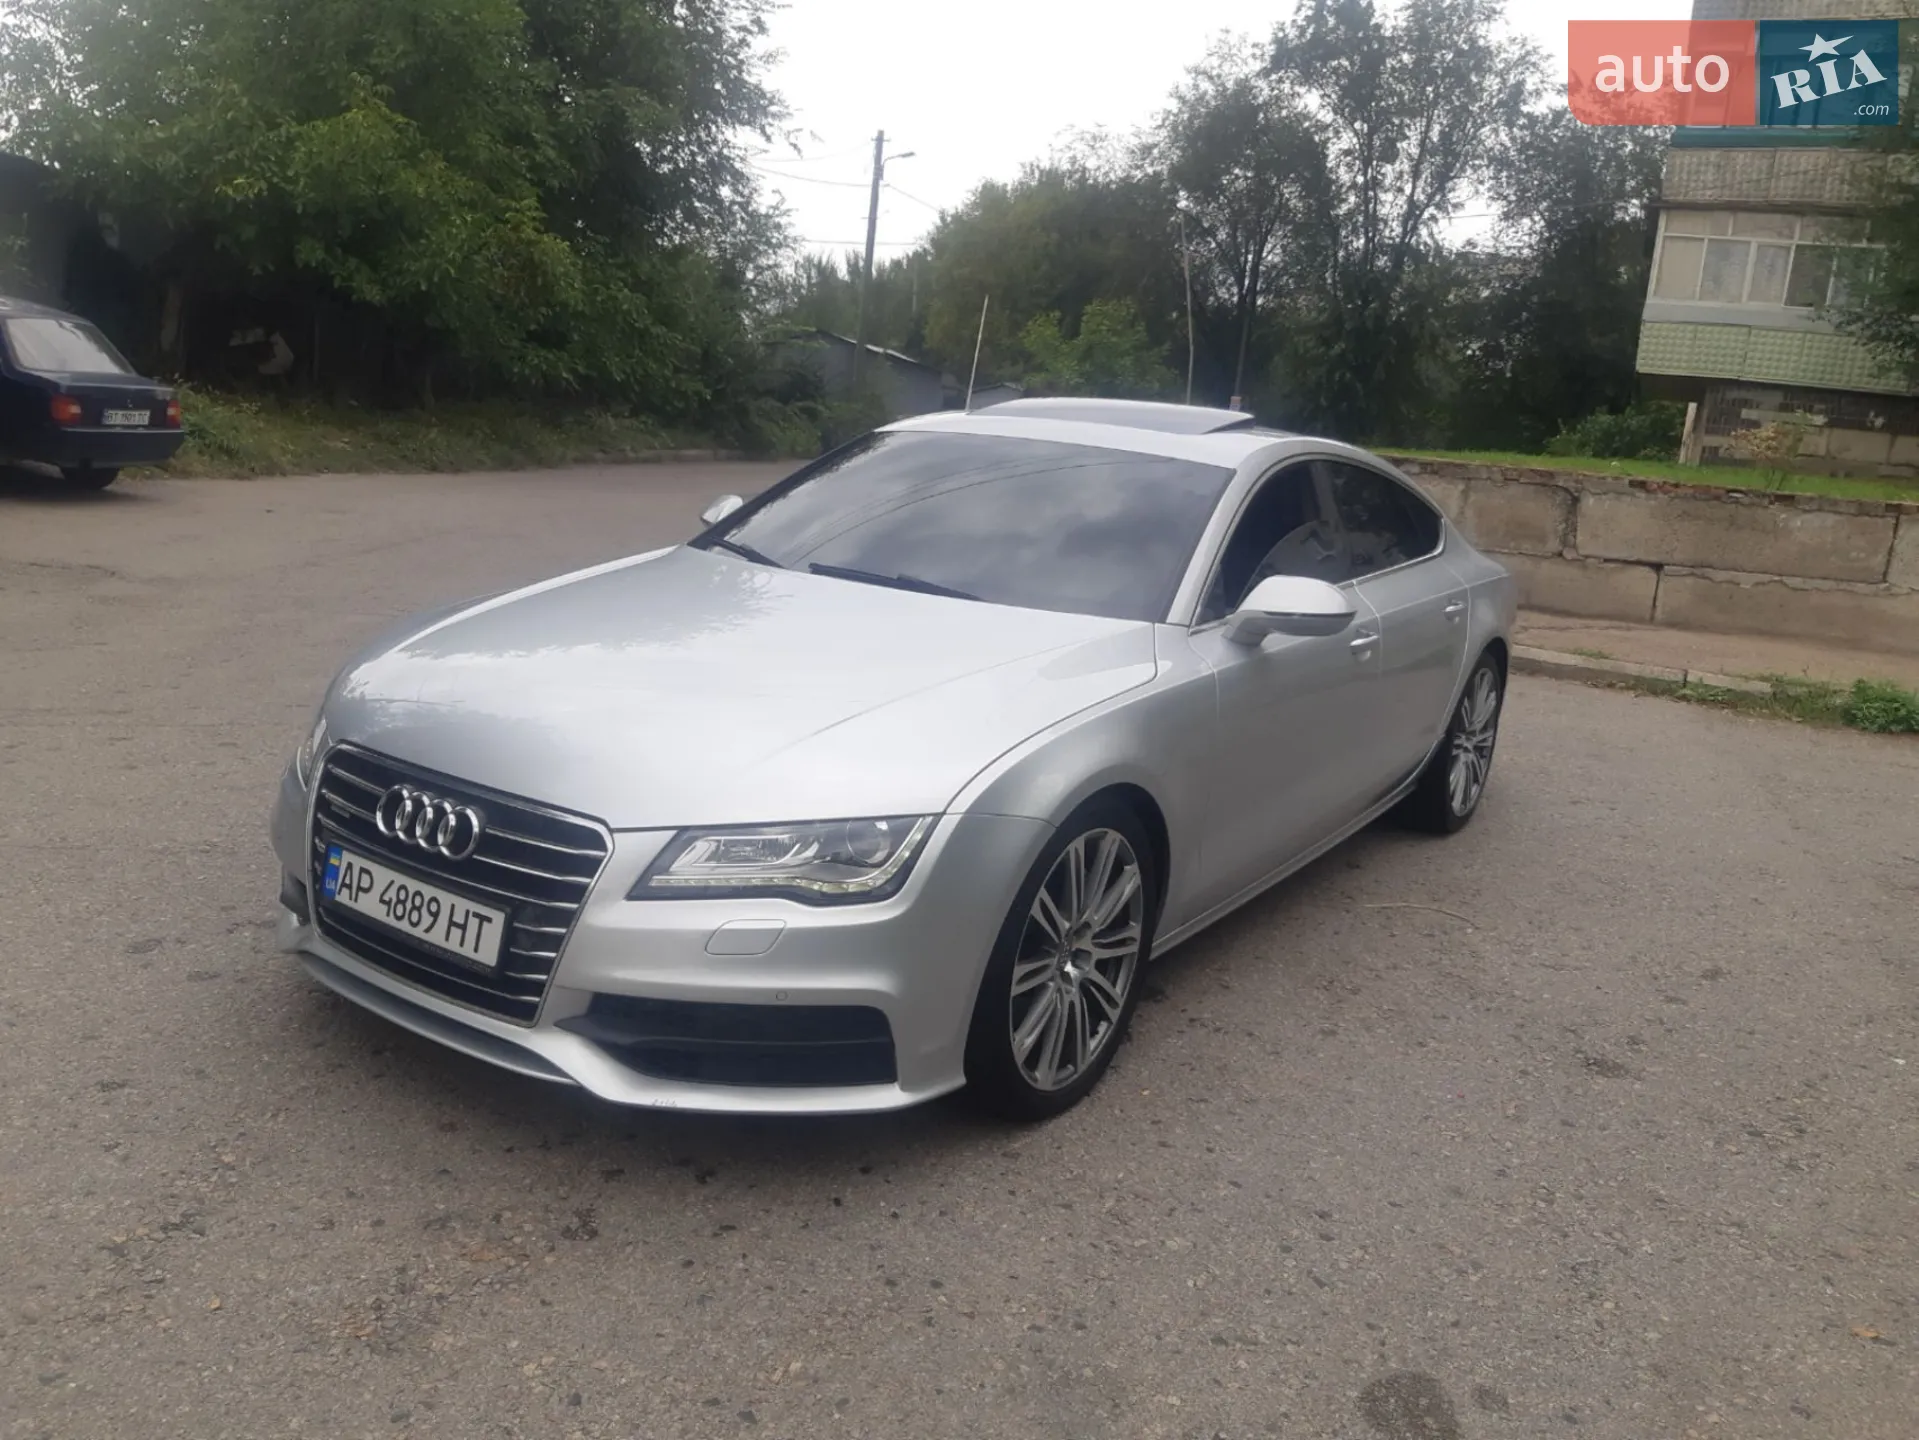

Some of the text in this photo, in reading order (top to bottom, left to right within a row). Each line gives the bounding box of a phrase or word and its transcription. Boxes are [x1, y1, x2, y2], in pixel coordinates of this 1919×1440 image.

[337, 861, 493, 954] AP 4889 HT
